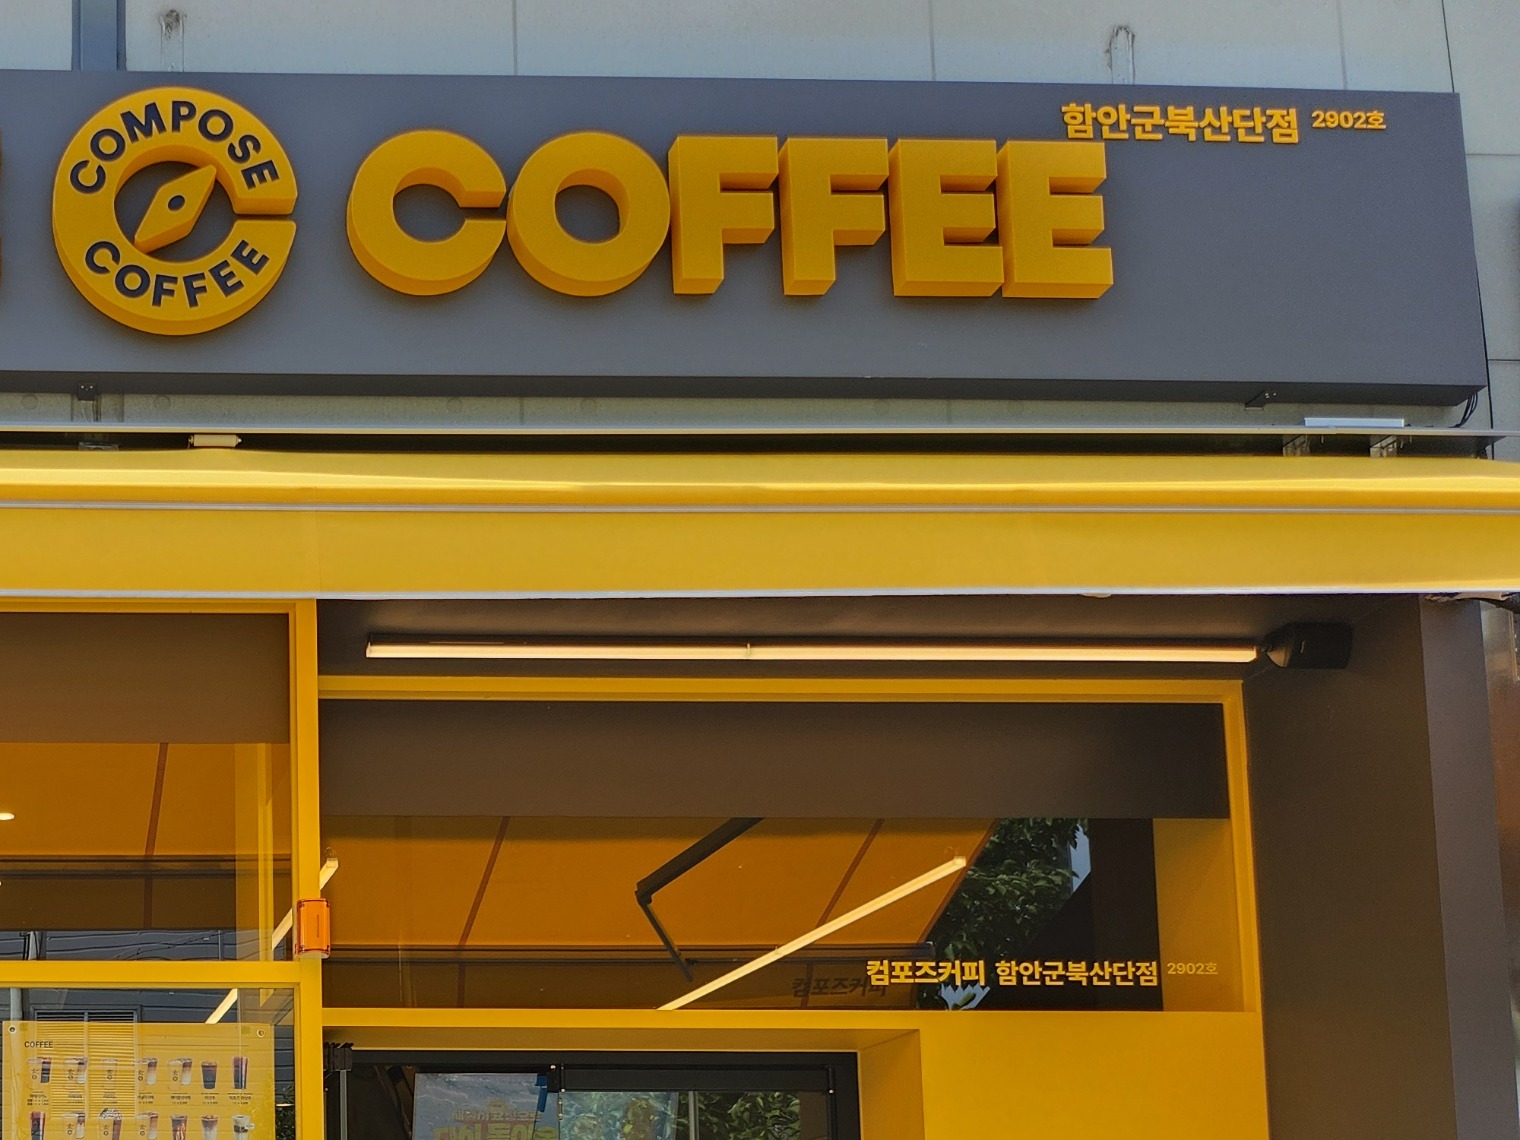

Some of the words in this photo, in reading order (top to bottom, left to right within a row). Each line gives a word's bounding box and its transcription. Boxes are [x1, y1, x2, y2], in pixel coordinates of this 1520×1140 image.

[69, 100, 281, 194] COMPOSE
[1061, 103, 1299, 144] 함안군북산단점
[1312, 110, 1387, 130] 2902호
[346, 129, 1113, 298] COFFEE
[84, 239, 270, 309] COFFEE
[866, 959, 986, 987] 컴포즈커피
[995, 959, 1159, 987] 함안군북산단점
[1167, 961, 1219, 976] 2902호
